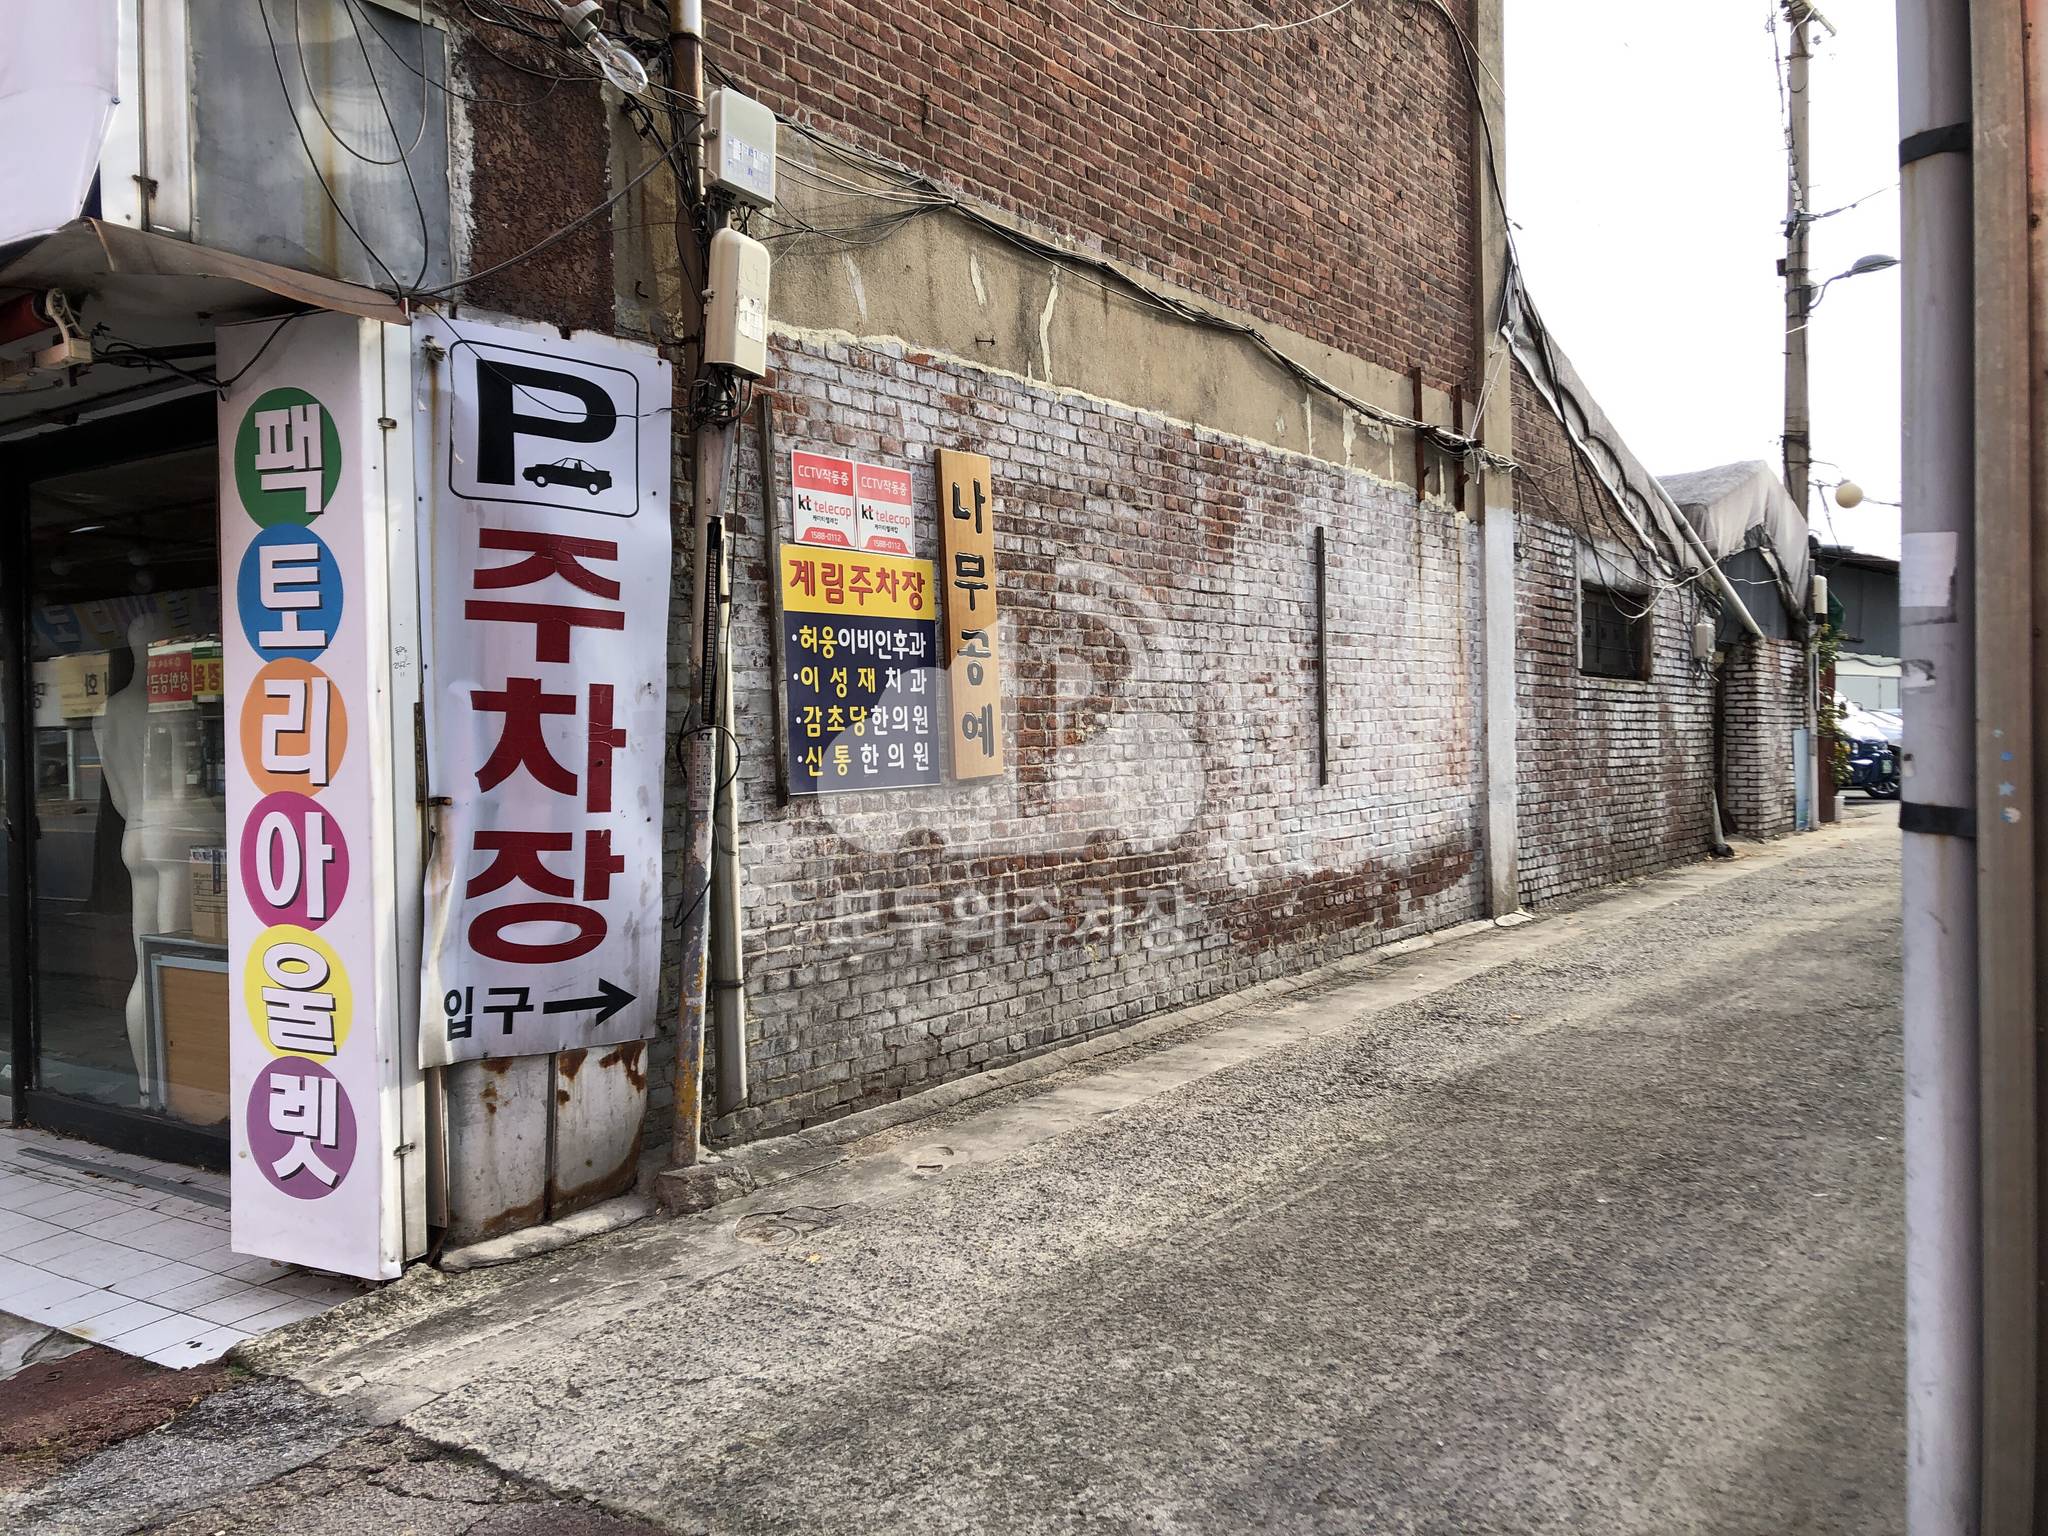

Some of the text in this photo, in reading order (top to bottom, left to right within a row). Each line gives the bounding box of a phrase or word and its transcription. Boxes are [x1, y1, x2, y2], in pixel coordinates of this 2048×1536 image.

[476, 359, 617, 486] P
[797, 465, 850, 487] CCTV작동중
[861, 475, 908, 497] CCTV작동중
[798, 494, 852, 519] kt telecop
[861, 503, 911, 528] kt telecop
[810, 531, 842, 542] 1588-0112
[873, 540, 901, 550] 1588-0112
[788, 559, 926, 611] 계림주차장
[951, 479, 996, 758] 나무공예
[803, 704, 929, 738] 감초당한의원
[464, 528, 627, 964] 주차장
[253, 402, 341, 1190] 팩토리아울렛
[443, 985, 535, 1042] 입구
